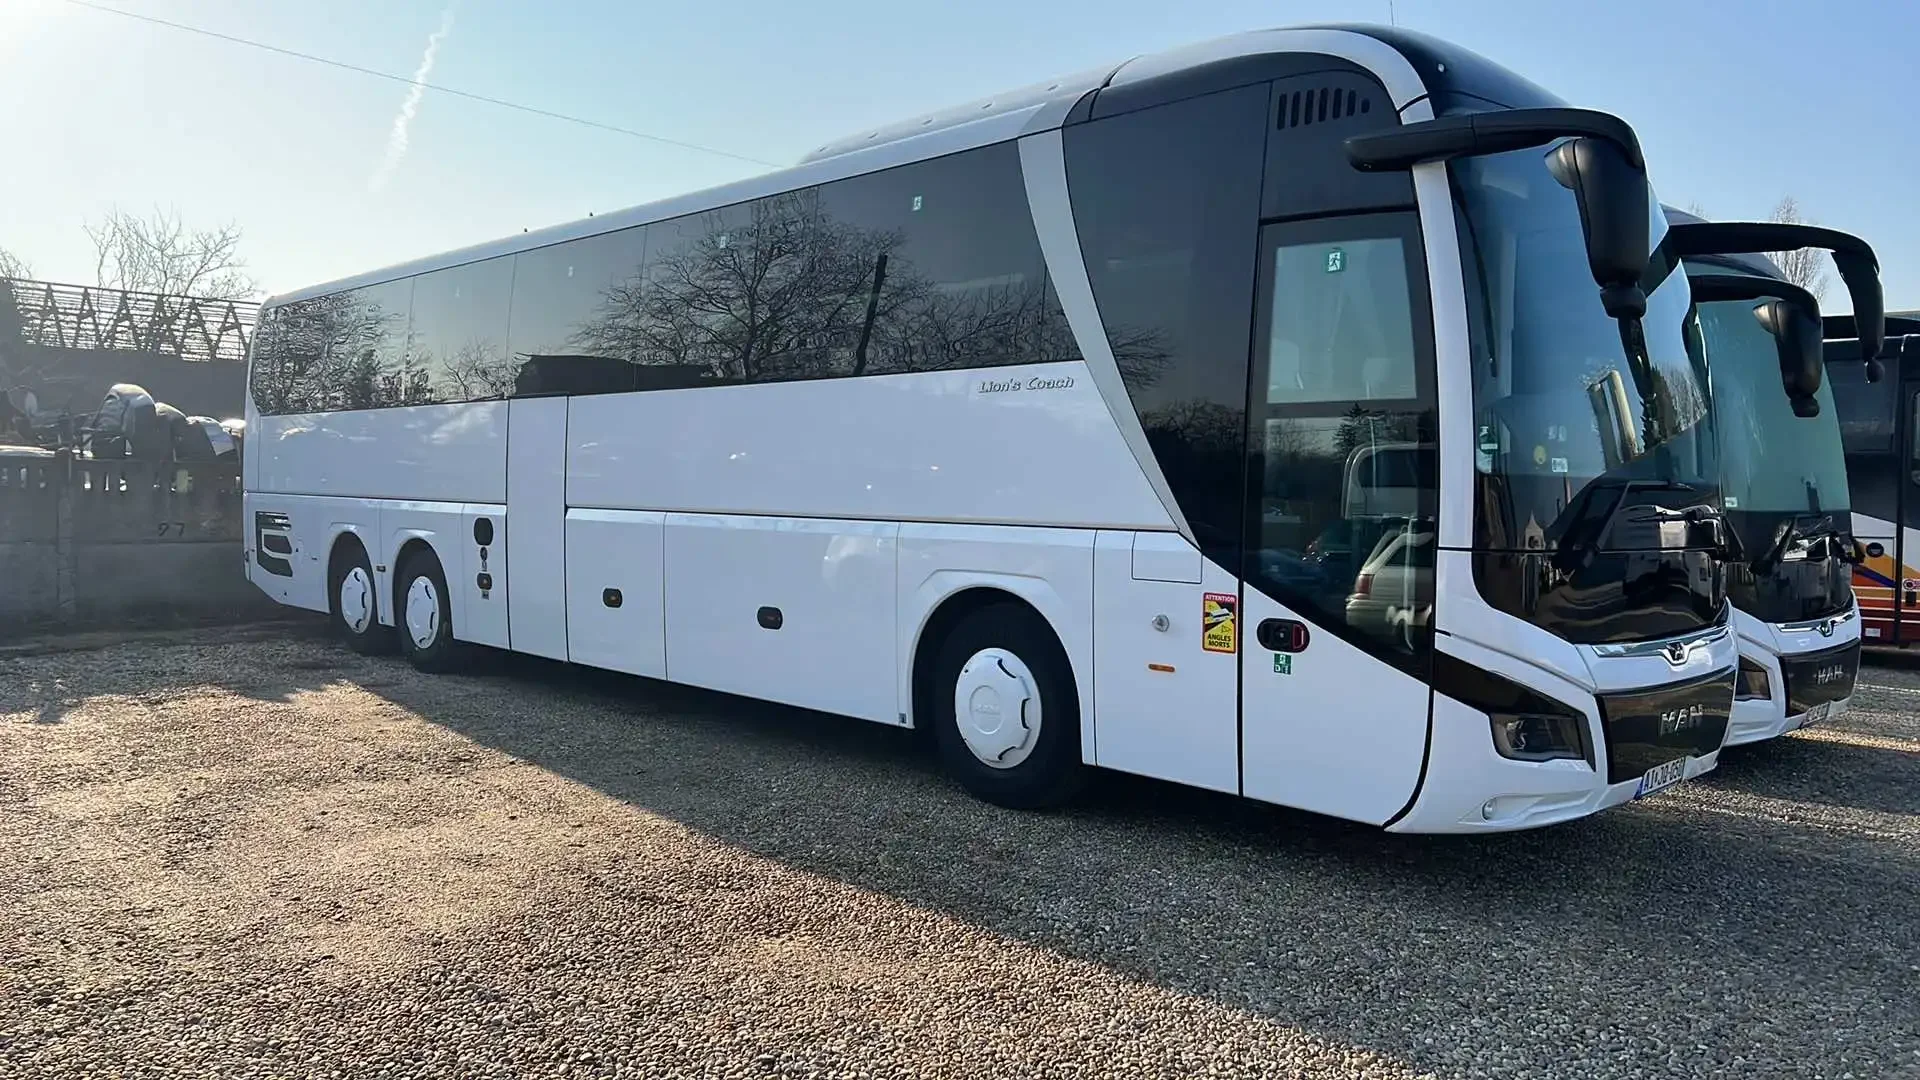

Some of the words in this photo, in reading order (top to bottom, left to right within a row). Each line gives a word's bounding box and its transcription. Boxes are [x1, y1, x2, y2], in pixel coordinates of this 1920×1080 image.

[978, 378, 1021, 393] Lion's
[1026, 377, 1074, 390] Coach
[1205, 593, 1236, 603] ATTENTION
[1207, 633, 1232, 642] ANGLES
[1208, 640, 1231, 648] MORTS
[1660, 704, 1703, 735] MAN
